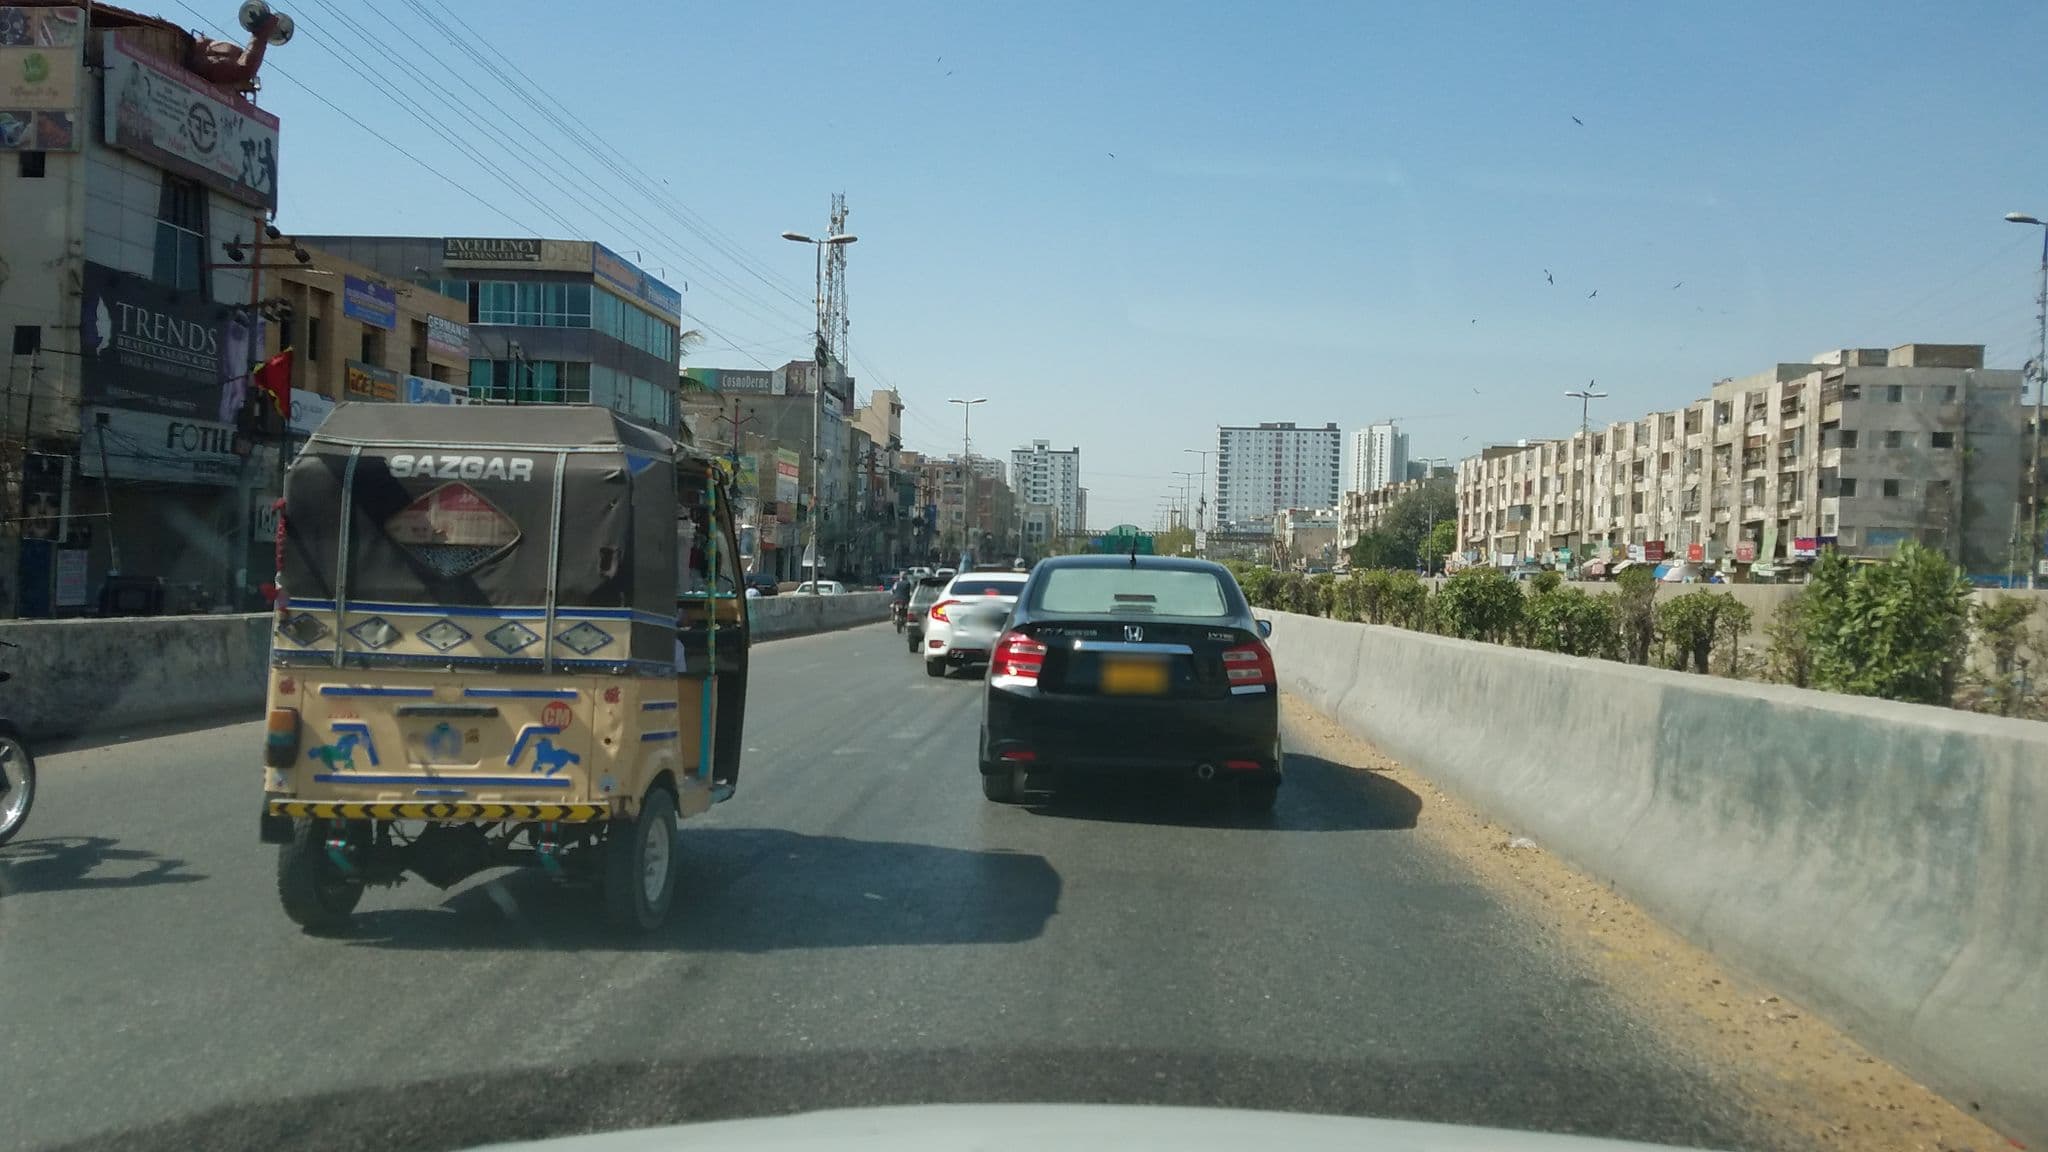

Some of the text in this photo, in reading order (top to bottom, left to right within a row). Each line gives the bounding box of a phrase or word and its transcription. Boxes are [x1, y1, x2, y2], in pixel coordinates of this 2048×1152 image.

[447, 239, 535, 252] EXCELLENCY
[459, 251, 497, 260] FITNESS
[116, 302, 217, 355] TRENDS
[117, 336, 157, 355] BEAUTY
[159, 345, 191, 361] SALON
[722, 375, 769, 389] CosmoDerme
[389, 454, 534, 482] SAZGAR
